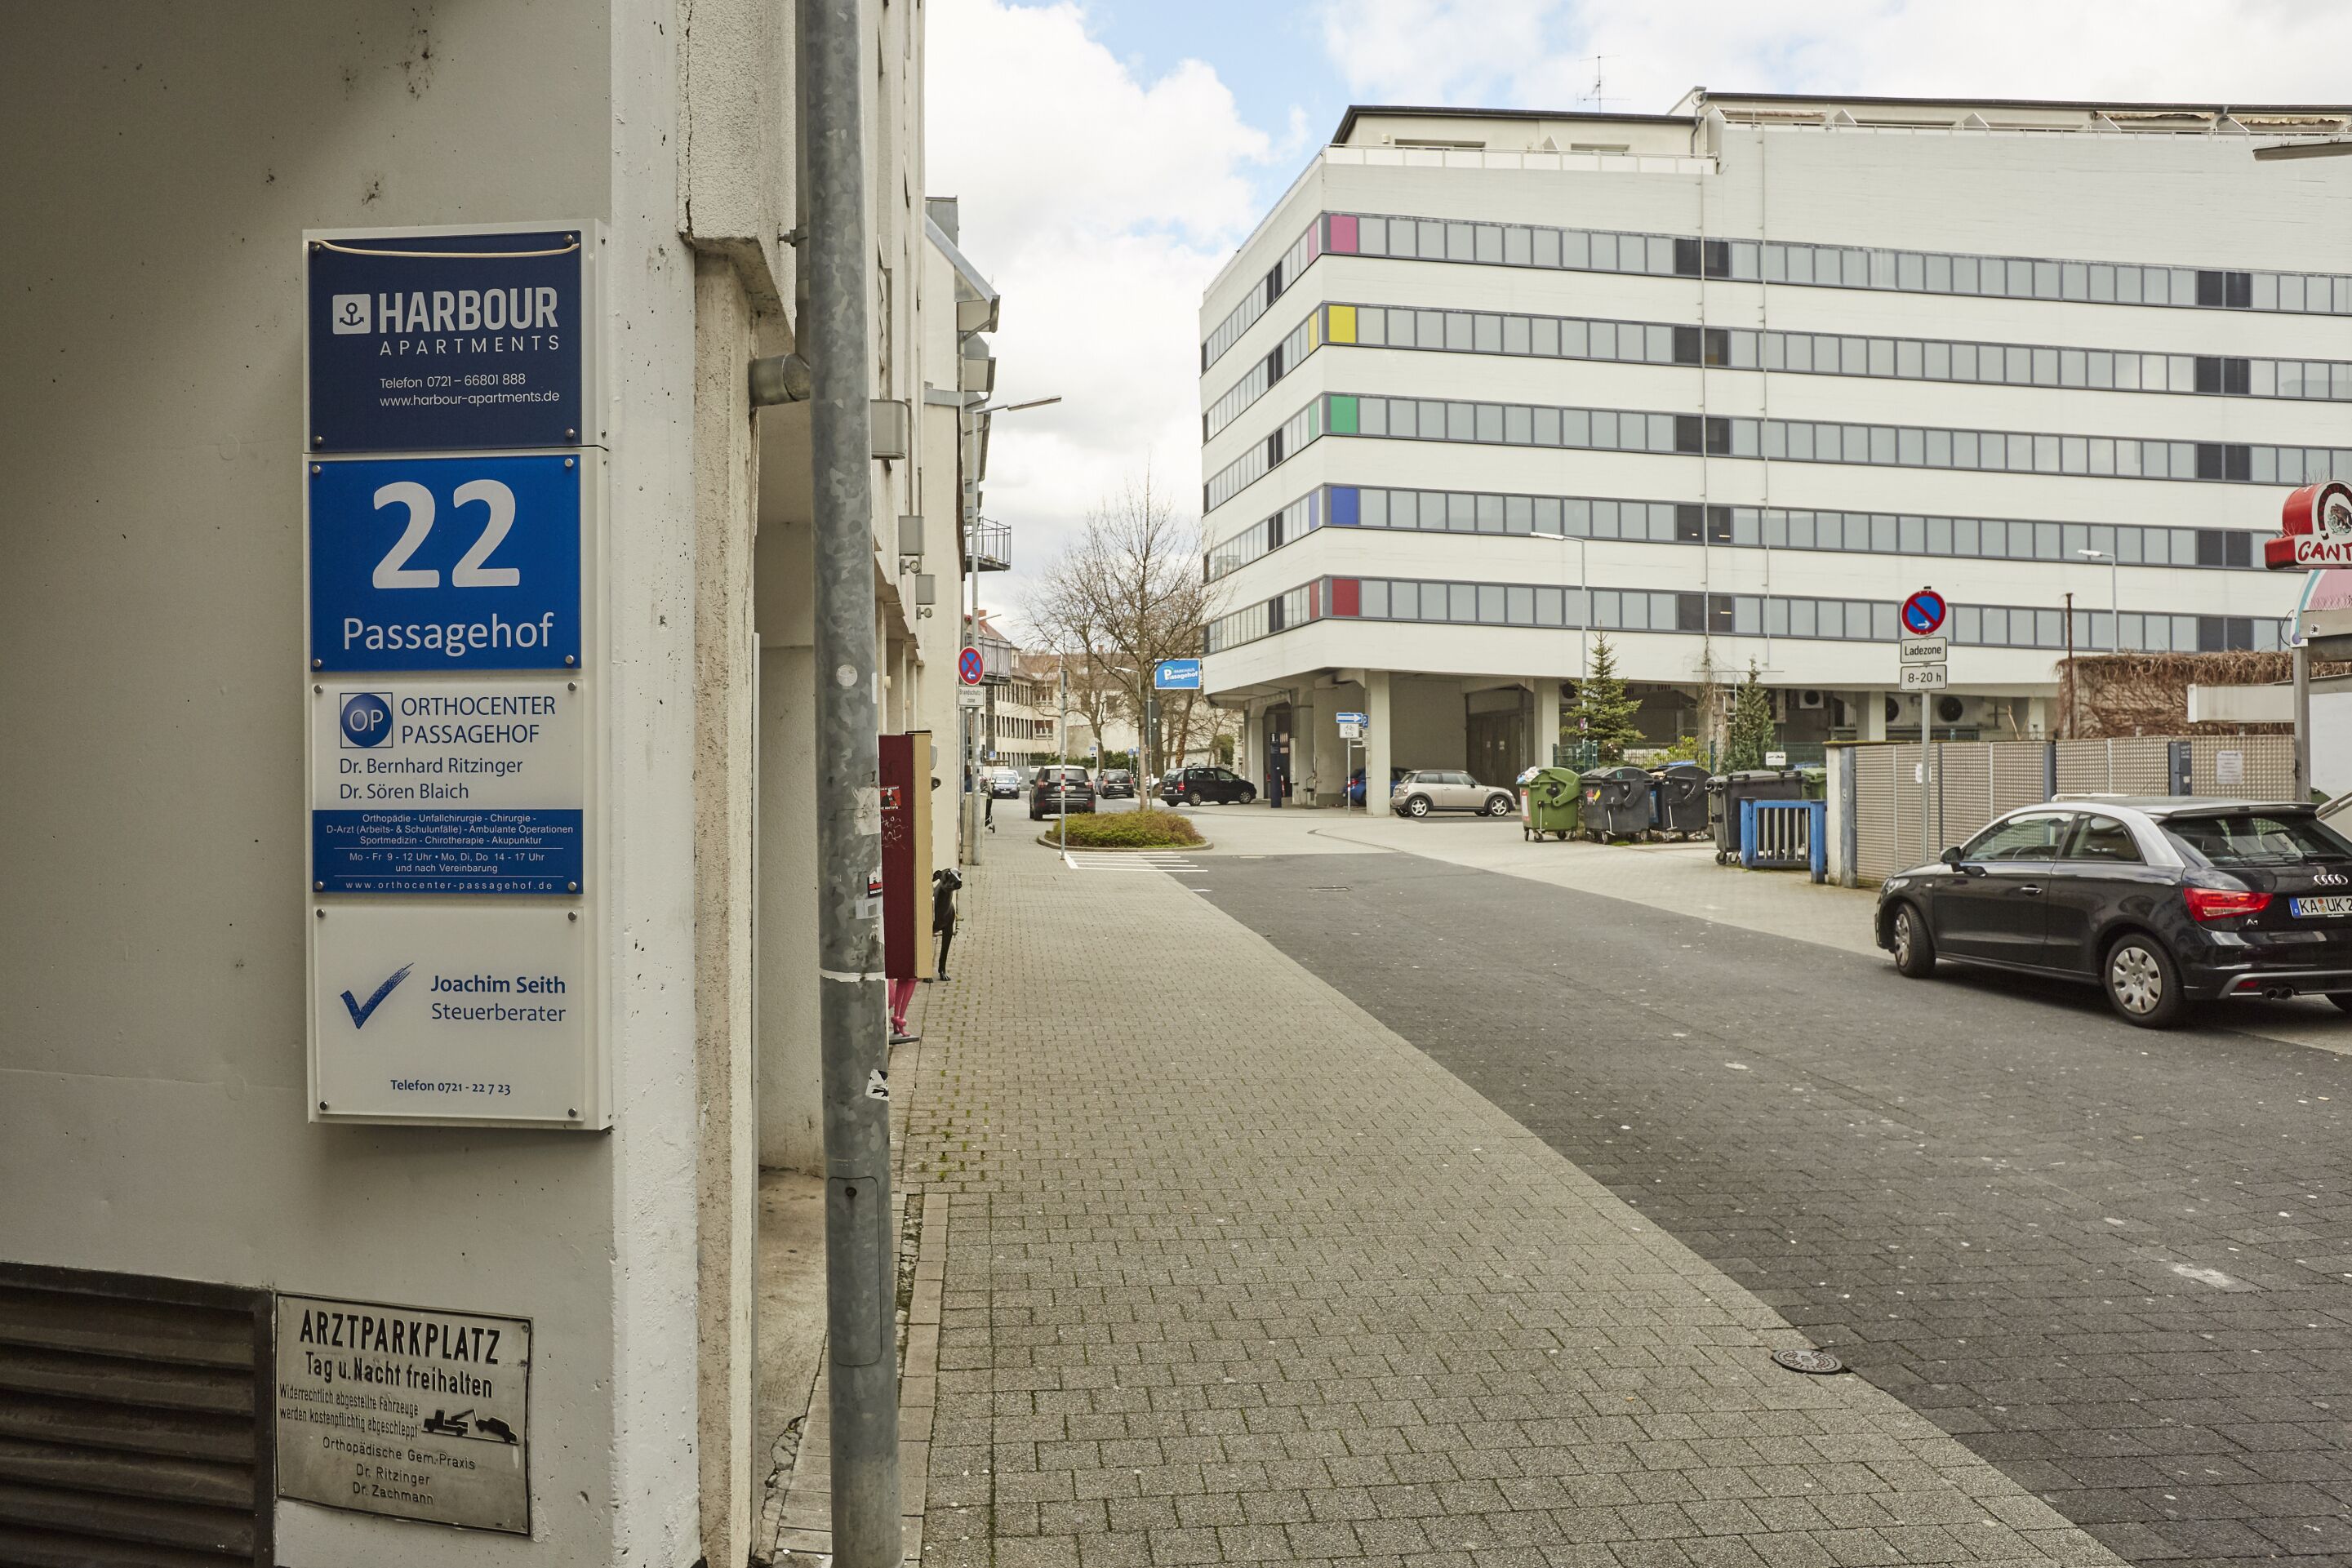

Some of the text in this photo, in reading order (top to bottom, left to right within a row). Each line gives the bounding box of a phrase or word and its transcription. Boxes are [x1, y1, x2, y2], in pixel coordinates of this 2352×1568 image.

[379, 287, 558, 334] HARBOUR
[380, 335, 559, 356] APARTMENTS
[380, 378, 422, 389] Telefon
[427, 375, 451, 387] 0721
[465, 374, 499, 386] 66801
[502, 373, 526, 384] 888
[380, 390, 559, 406] www.harbour-apartments.de
[372, 479, 520, 589] 22
[344, 612, 554, 657] Passagehof
[1905, 646, 1941, 655] Ladezone
[1908, 673, 1941, 683] 8-20 h
[401, 696, 555, 716] ORTHOCENTER
[349, 709, 384, 731] OP
[402, 724, 540, 744] PASSAGEHOF
[340, 757, 522, 777] Dr. Bernhard Ritzinger
[340, 783, 469, 799] Dr. Sören Blaich
[362, 815, 411, 824] Orthopädie
[419, 815, 482, 824] Unfallchirurgie
[490, 814, 531, 824] Chirurgie
[327, 825, 354, 833] D-Arzt
[357, 825, 393, 835] (Arbeits-
[396, 825, 402, 833] &
[405, 825, 462, 835] Schulunfälle)
[469, 825, 516, 833] Ambulante
[518, 825, 573, 835] Operationen
[360, 836, 417, 846] Sportmedizin
[425, 836, 484, 846] Chirotherapie
[491, 836, 542, 845] Akupunktur
[349, 853, 363, 861] Mo
[372, 853, 382, 861] Fr
[387, 853, 393, 861] 9
[403, 853, 413, 861] 12
[416, 853, 432, 861] Uhr
[441, 853, 457, 863] Mo,
[460, 853, 473, 863] Di,
[475, 853, 488, 861] Do
[495, 853, 505, 861] 14
[515, 853, 525, 861] 17
[528, 853, 545, 861] Uhr
[395, 864, 498, 874] und nach Vereinbarung
[345, 881, 552, 891] www.orthocenter-passagehof.de
[2299, 899, 2319, 913] KA
[2326, 898, 2345, 912] UK
[430, 975, 566, 994] Joachim Seith
[432, 1002, 567, 1022] Steuerberater
[390, 1079, 434, 1091] Telefon
[438, 1082, 463, 1094] 0721
[472, 1083, 486, 1093] 22
[488, 1084, 495, 1095] 7
[497, 1084, 511, 1095] 23
[300, 1308, 500, 1365] ARZTPARKPLATZ
[305, 1351, 332, 1384] Tag
[407, 1364, 493, 1399] freihalten
[279, 1384, 419, 1419] Widerrechtlich abgestellte Fahrzeuge
[279, 1406, 419, 1441] werden kostenpflichtig abgeschleppt
[322, 1436, 402, 1460] Orthopädische
[356, 1463, 431, 1486] Dr. Ritzinger
[353, 1481, 433, 1505] Dr. Zachmann
